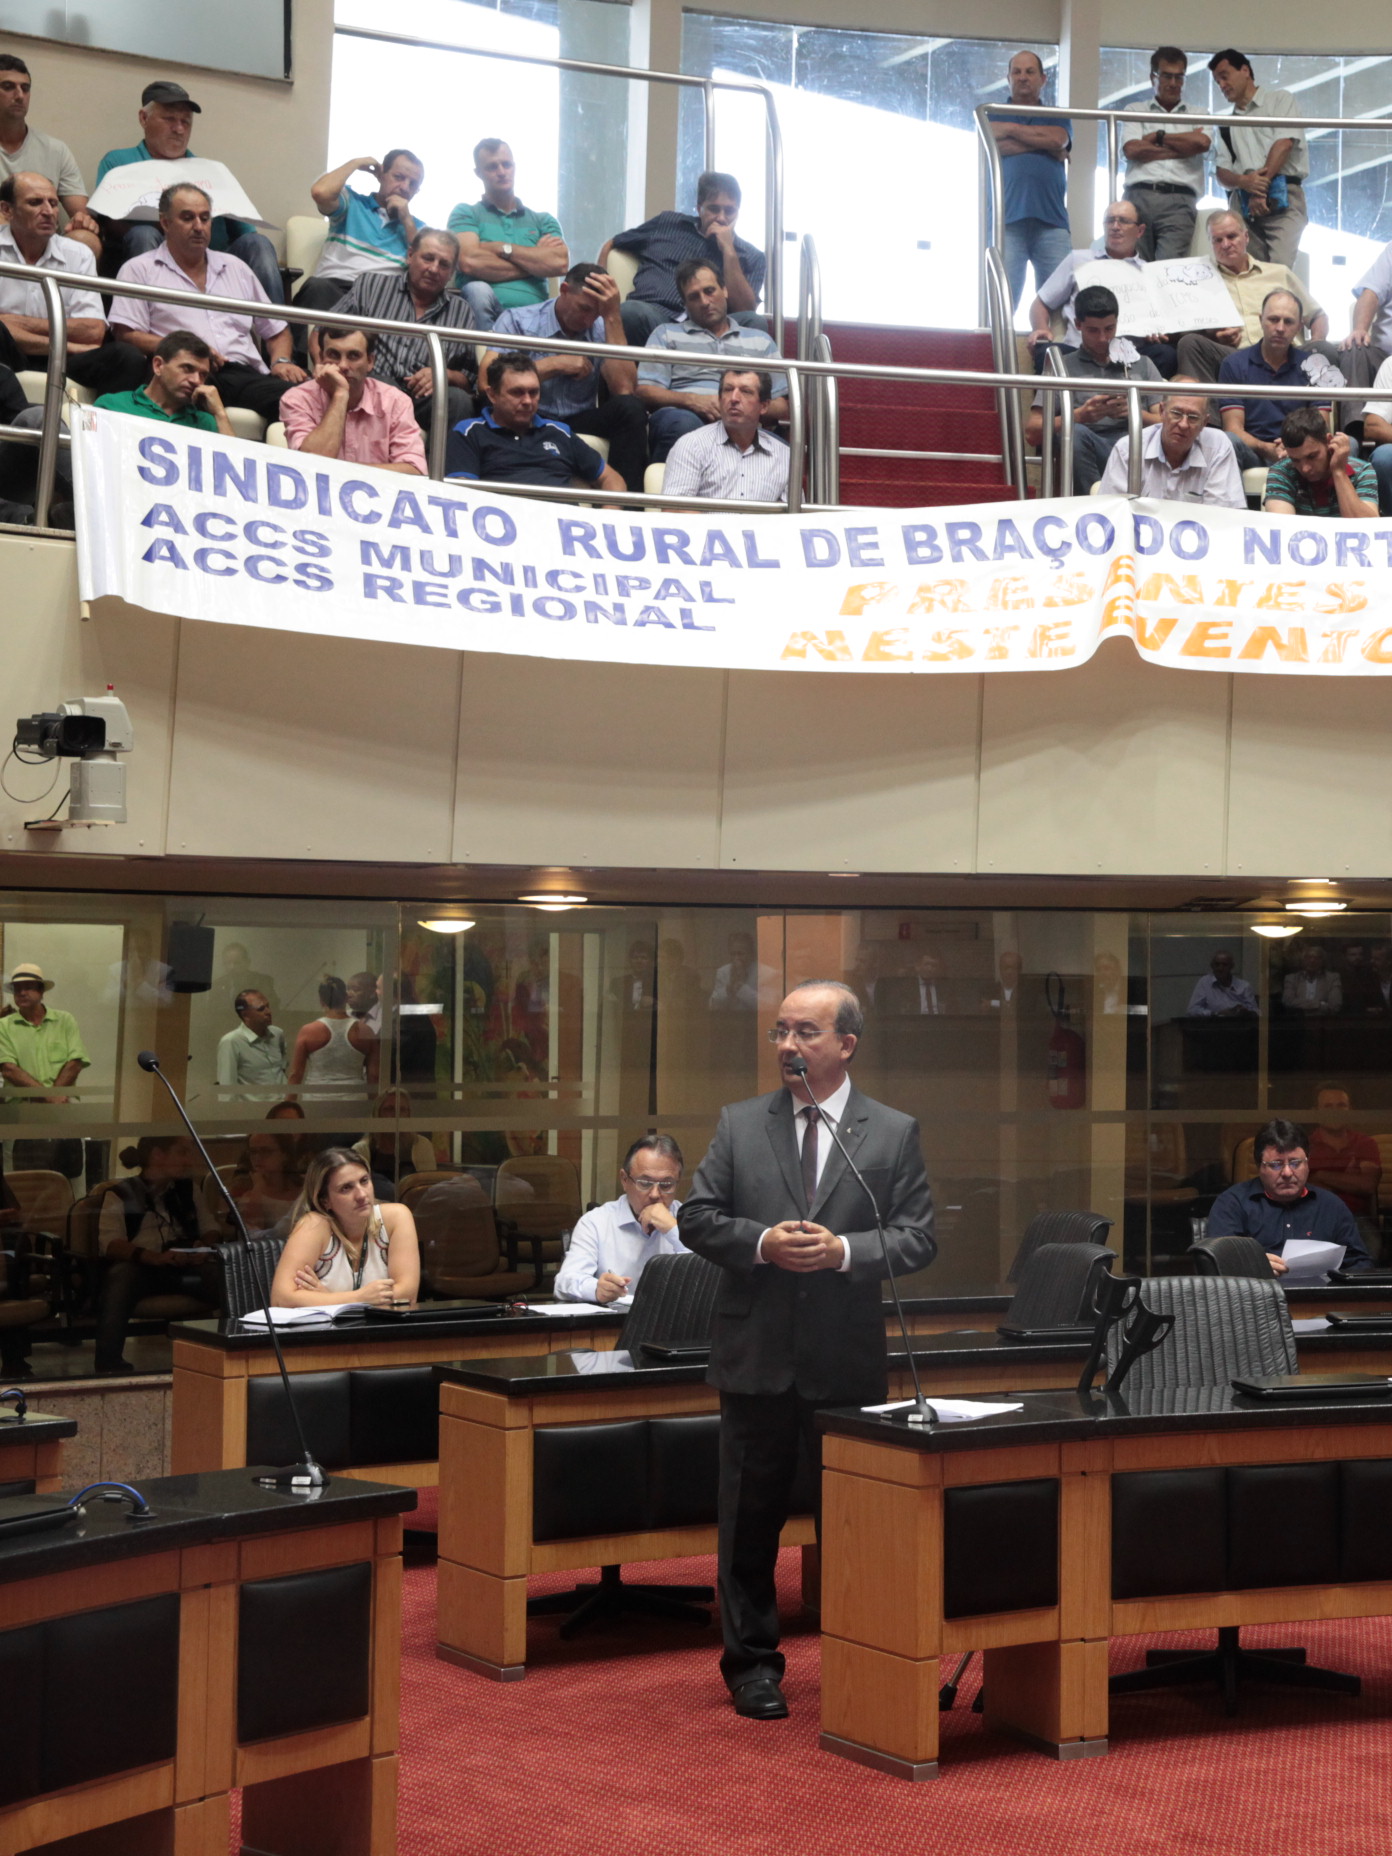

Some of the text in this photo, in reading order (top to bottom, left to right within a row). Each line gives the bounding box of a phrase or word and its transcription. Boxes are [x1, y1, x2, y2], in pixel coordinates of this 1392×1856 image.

[137, 435, 517, 547] SINDICATO
[557, 517, 781, 569] RURAL
[800, 526, 885, 569] DE
[900, 513, 1116, 570] BRAÇO
[1134, 513, 1210, 560] DO
[141, 503, 736, 605] ACCS MUNICIPAL
[141, 538, 716, 632] ACCS REGIONAL
[839, 555, 1370, 616] PRESENTES
[780, 619, 1078, 662] NESTE
